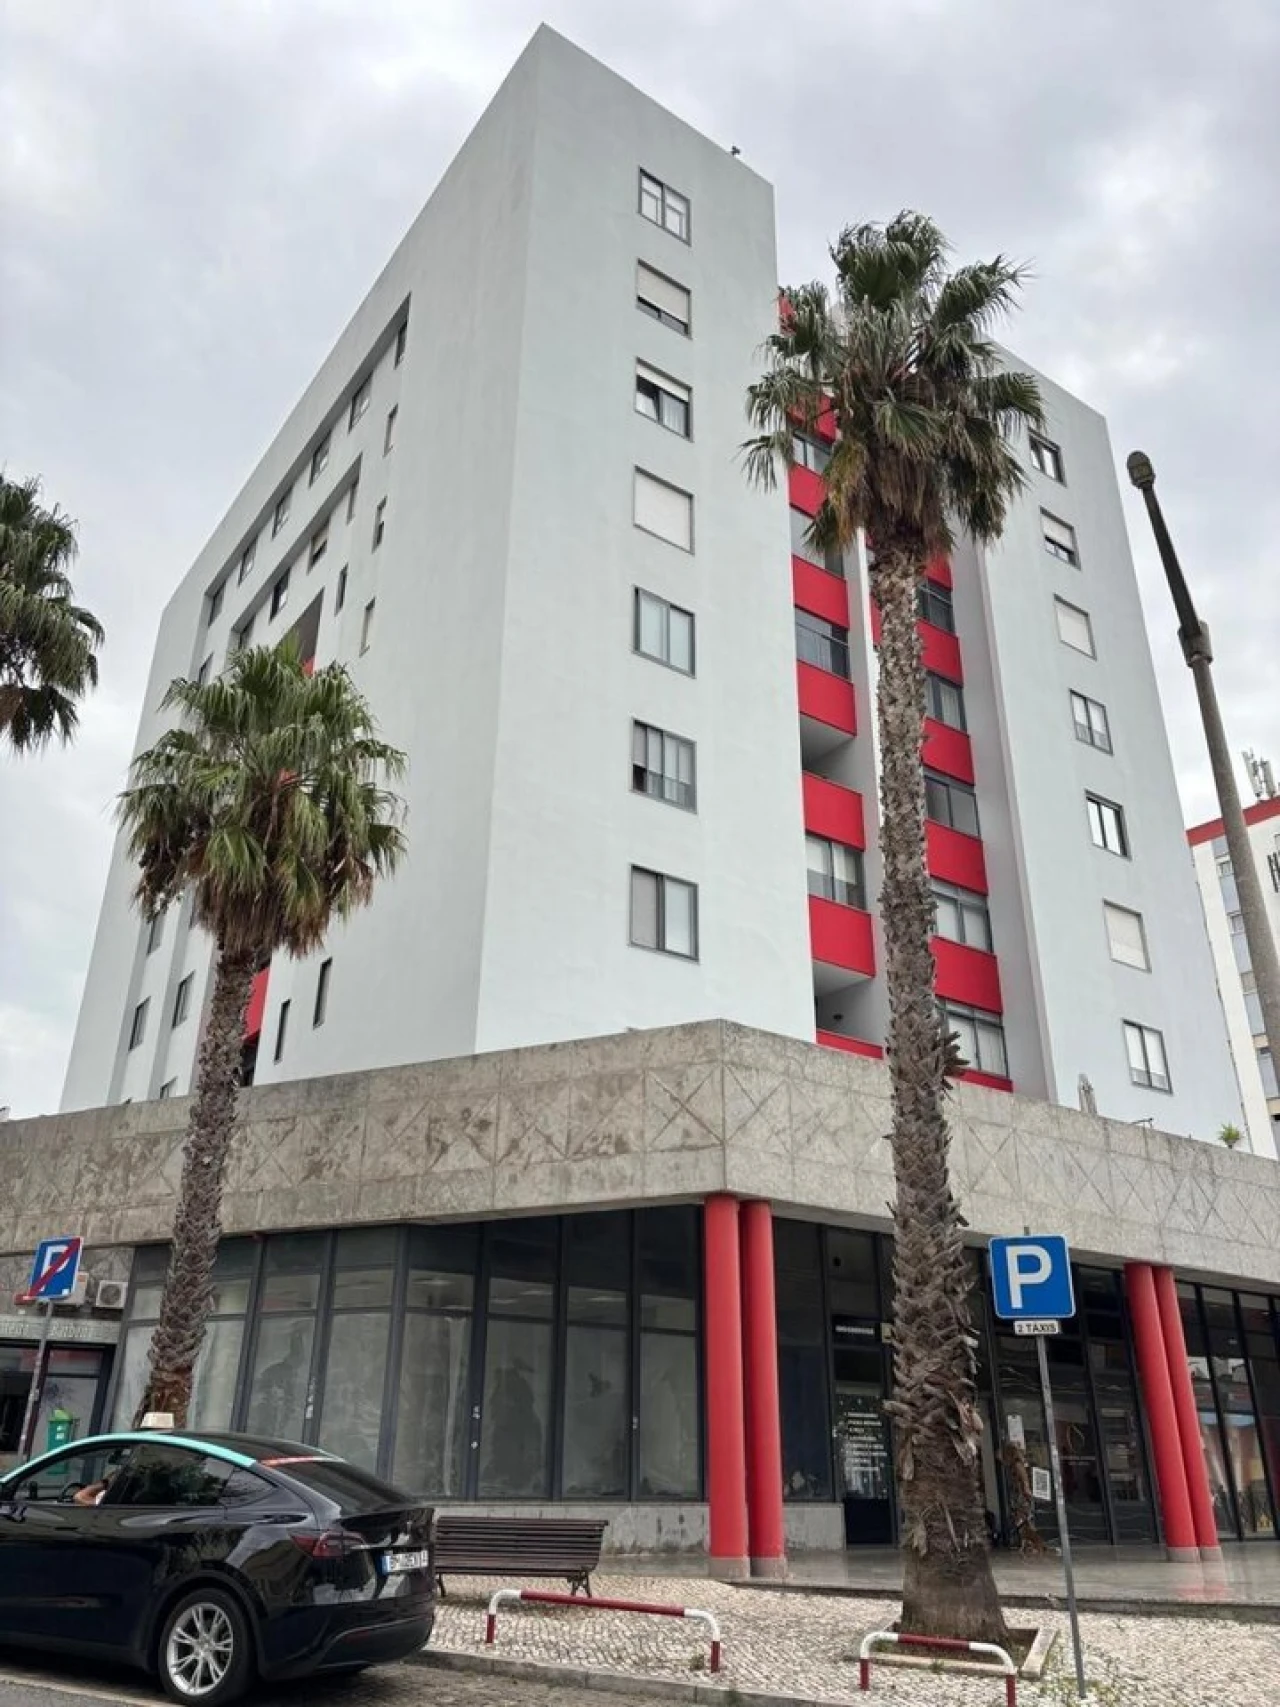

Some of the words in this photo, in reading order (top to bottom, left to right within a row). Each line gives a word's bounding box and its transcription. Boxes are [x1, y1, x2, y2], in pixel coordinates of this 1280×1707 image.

[1006, 1245, 1052, 1309] P
[1016, 1323, 1023, 1333] 2
[1025, 1322, 1057, 1333] TAXIS
